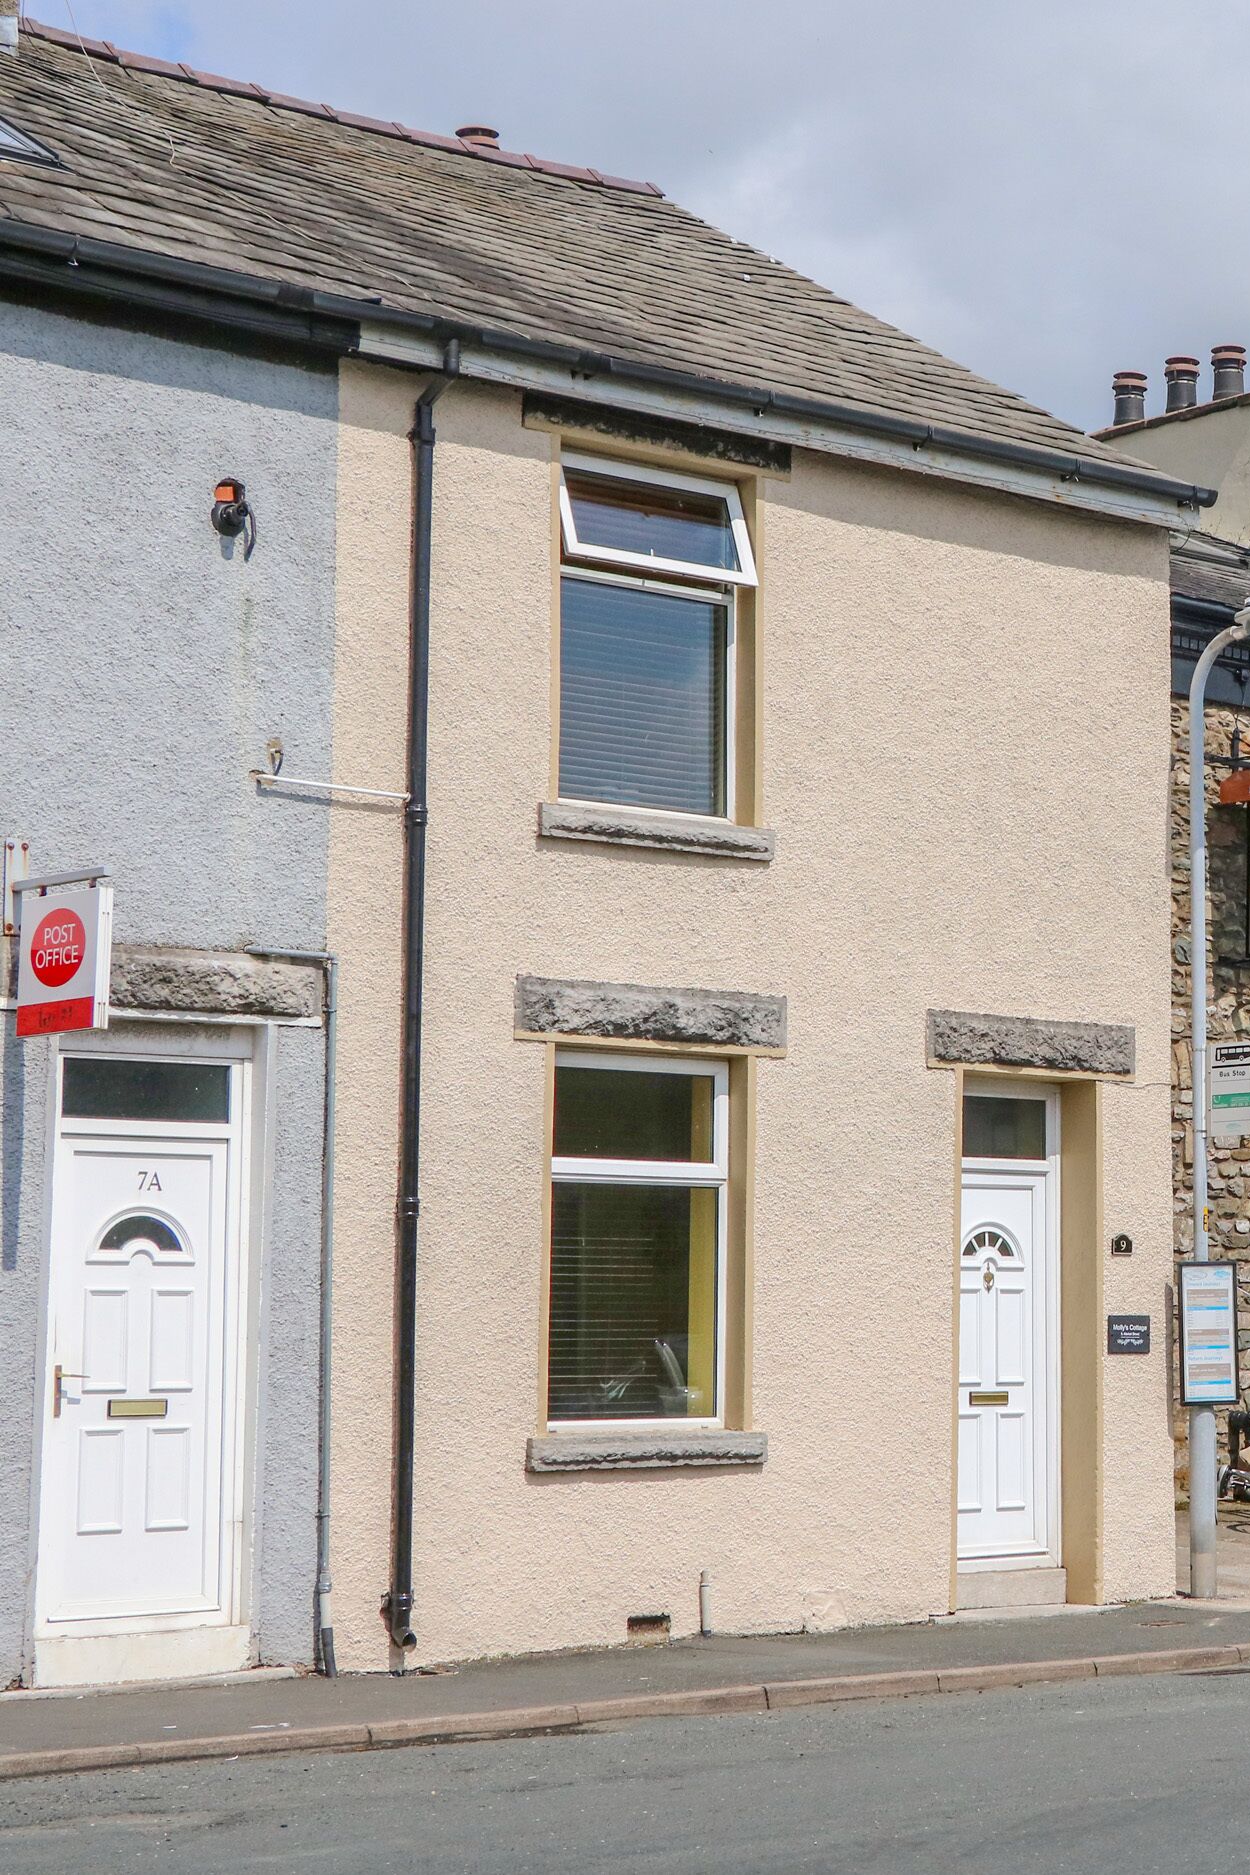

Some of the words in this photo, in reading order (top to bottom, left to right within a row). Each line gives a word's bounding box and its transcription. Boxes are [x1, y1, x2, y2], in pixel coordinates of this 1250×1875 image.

[44, 923, 76, 945] POST
[35, 945, 79, 968] OFFICE
[138, 1171, 162, 1192] 7A
[1120, 1240, 1127, 1251] 9
[1112, 1323, 1129, 1332] Molly's
[1129, 1324, 1148, 1332] Cottage
